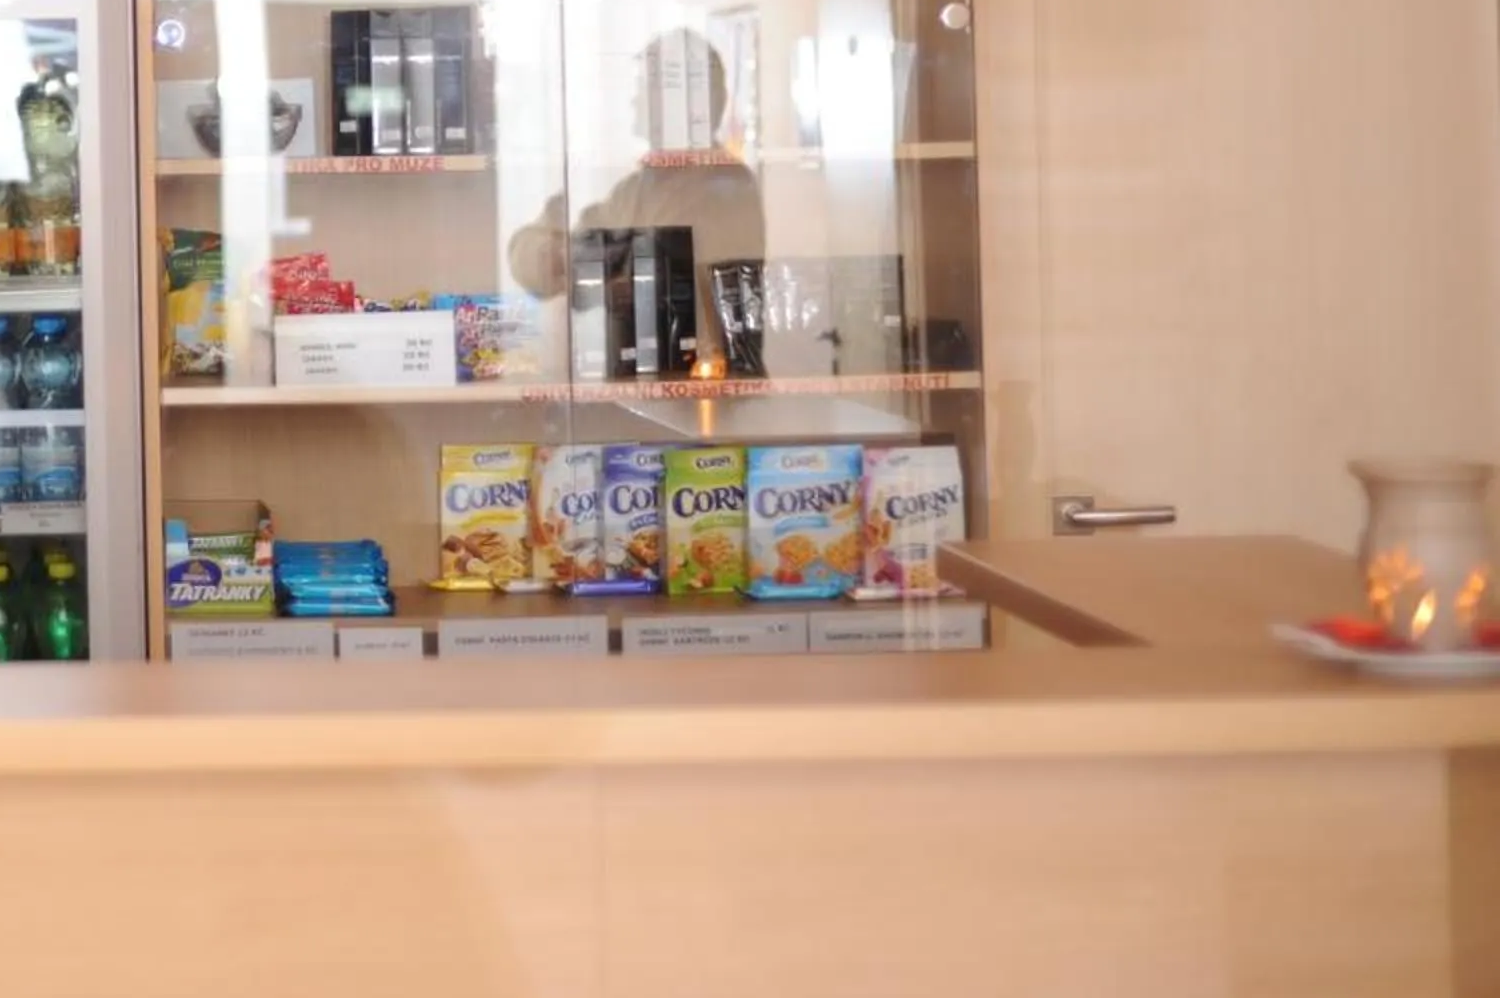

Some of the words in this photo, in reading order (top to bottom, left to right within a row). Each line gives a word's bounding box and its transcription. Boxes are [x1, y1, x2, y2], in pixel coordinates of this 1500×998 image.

[754, 480, 851, 519] CORNY
[886, 484, 959, 520] CORNY
[170, 583, 265, 601] TATRANKY
